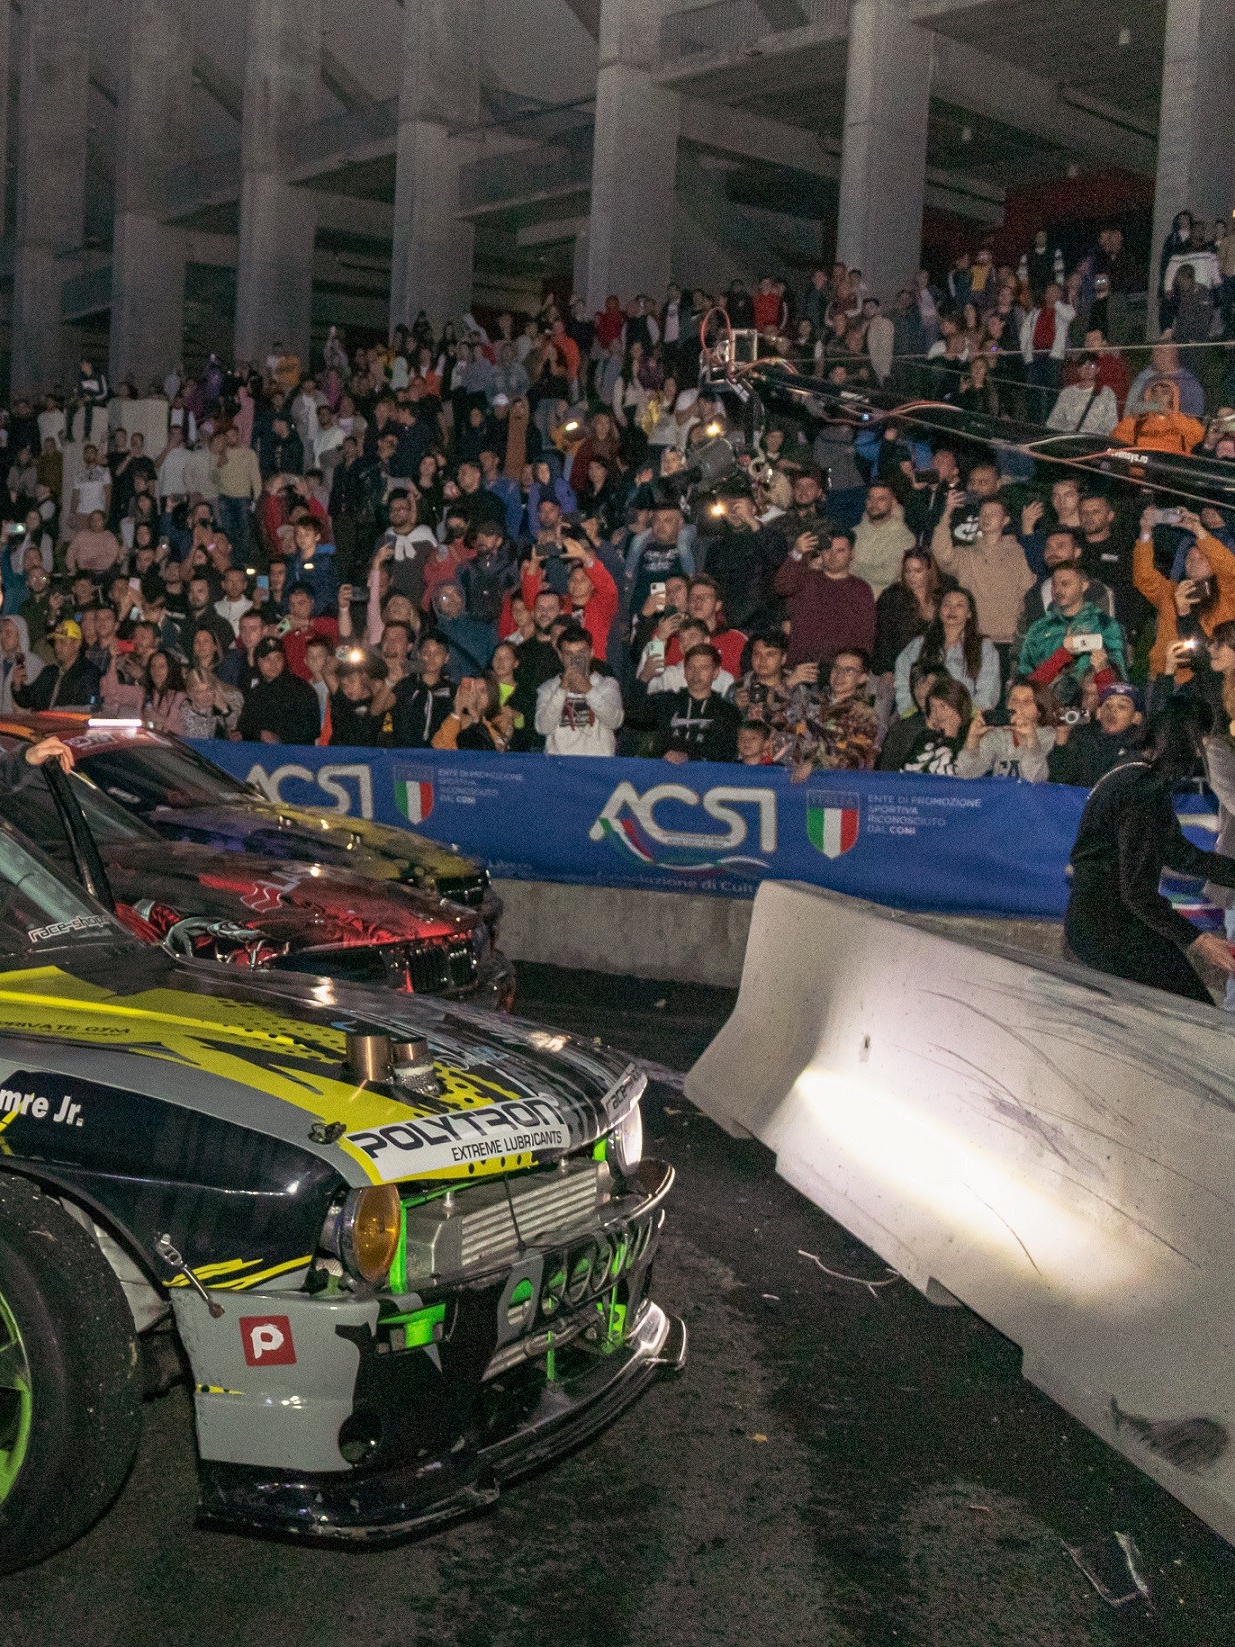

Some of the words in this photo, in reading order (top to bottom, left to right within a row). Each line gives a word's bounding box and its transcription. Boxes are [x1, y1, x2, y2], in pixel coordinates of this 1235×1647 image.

[868, 794, 895, 804] ENTE
[898, 795, 908, 805] DI
[911, 797, 982, 808] PROMOZIONE
[588, 780, 778, 853] ACSI
[868, 804, 919, 815] SPORTIVA
[867, 814, 947, 828] RICONOSCIUTO
[867, 826, 886, 836] DAL
[889, 826, 917, 836] CONI
[720, 877, 757, 895] Cult
[84, 1026, 130, 1035] GYM
[53, 1095, 85, 1127] Jr.
[346, 1099, 566, 1159] POLYTRON
[451, 1139, 503, 1162] EXTREME
[504, 1130, 563, 1155] LUBRICANTS
